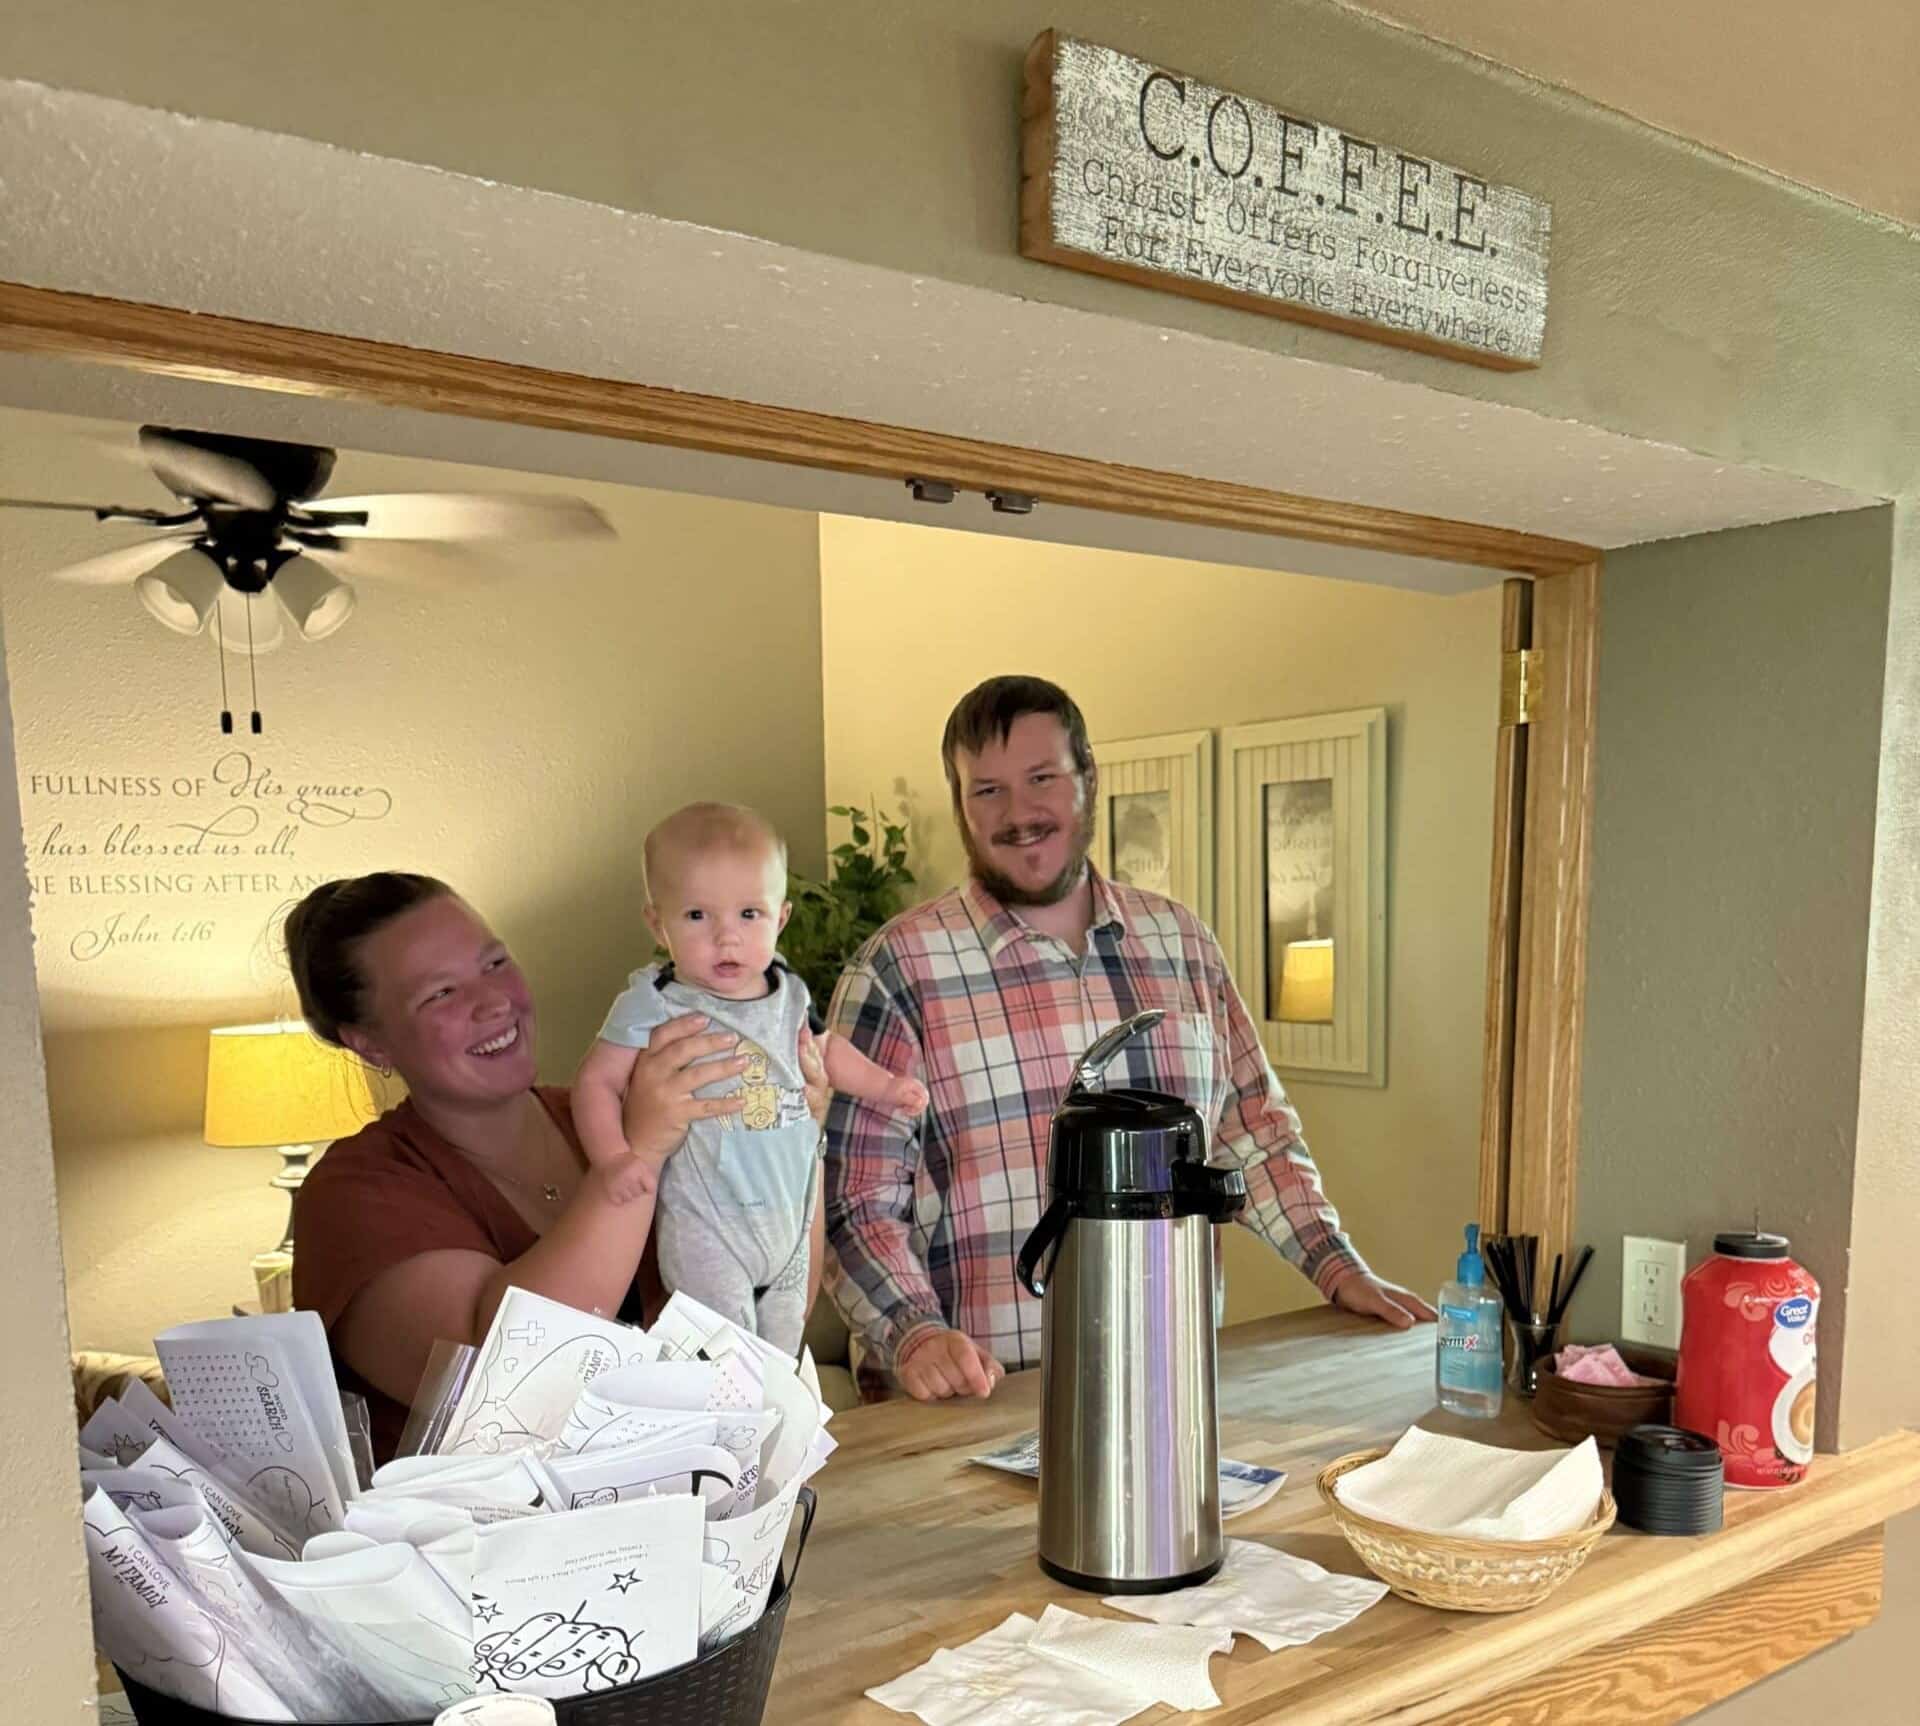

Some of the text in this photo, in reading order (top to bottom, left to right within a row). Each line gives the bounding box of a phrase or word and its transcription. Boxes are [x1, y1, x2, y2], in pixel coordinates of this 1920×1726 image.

[1139, 72, 1497, 257] C.O.F.F.E.E.
[1083, 159, 1530, 314] Christ Offers Forgiveness
[1102, 215, 1512, 352] For Everyone Everywhere
[31, 752, 393, 828] FULLNESS OF His grace
[42, 805, 299, 859] has blessed us all,
[31, 875, 57, 896] NE
[69, 874, 194, 896] BLESSING
[202, 873, 281, 895] AFTER
[70, 911, 216, 962] John 1:16
[1780, 1303, 1809, 1317] Great
[256, 1385, 286, 1431] SEARCH
[205, 1487, 224, 1507] CAN
[221, 1502, 243, 1522] LOVE
[102, 1545, 169, 1609] MY FAMILY
[133, 1550, 151, 1572] CAN
[149, 1568, 171, 1591] LOVE
